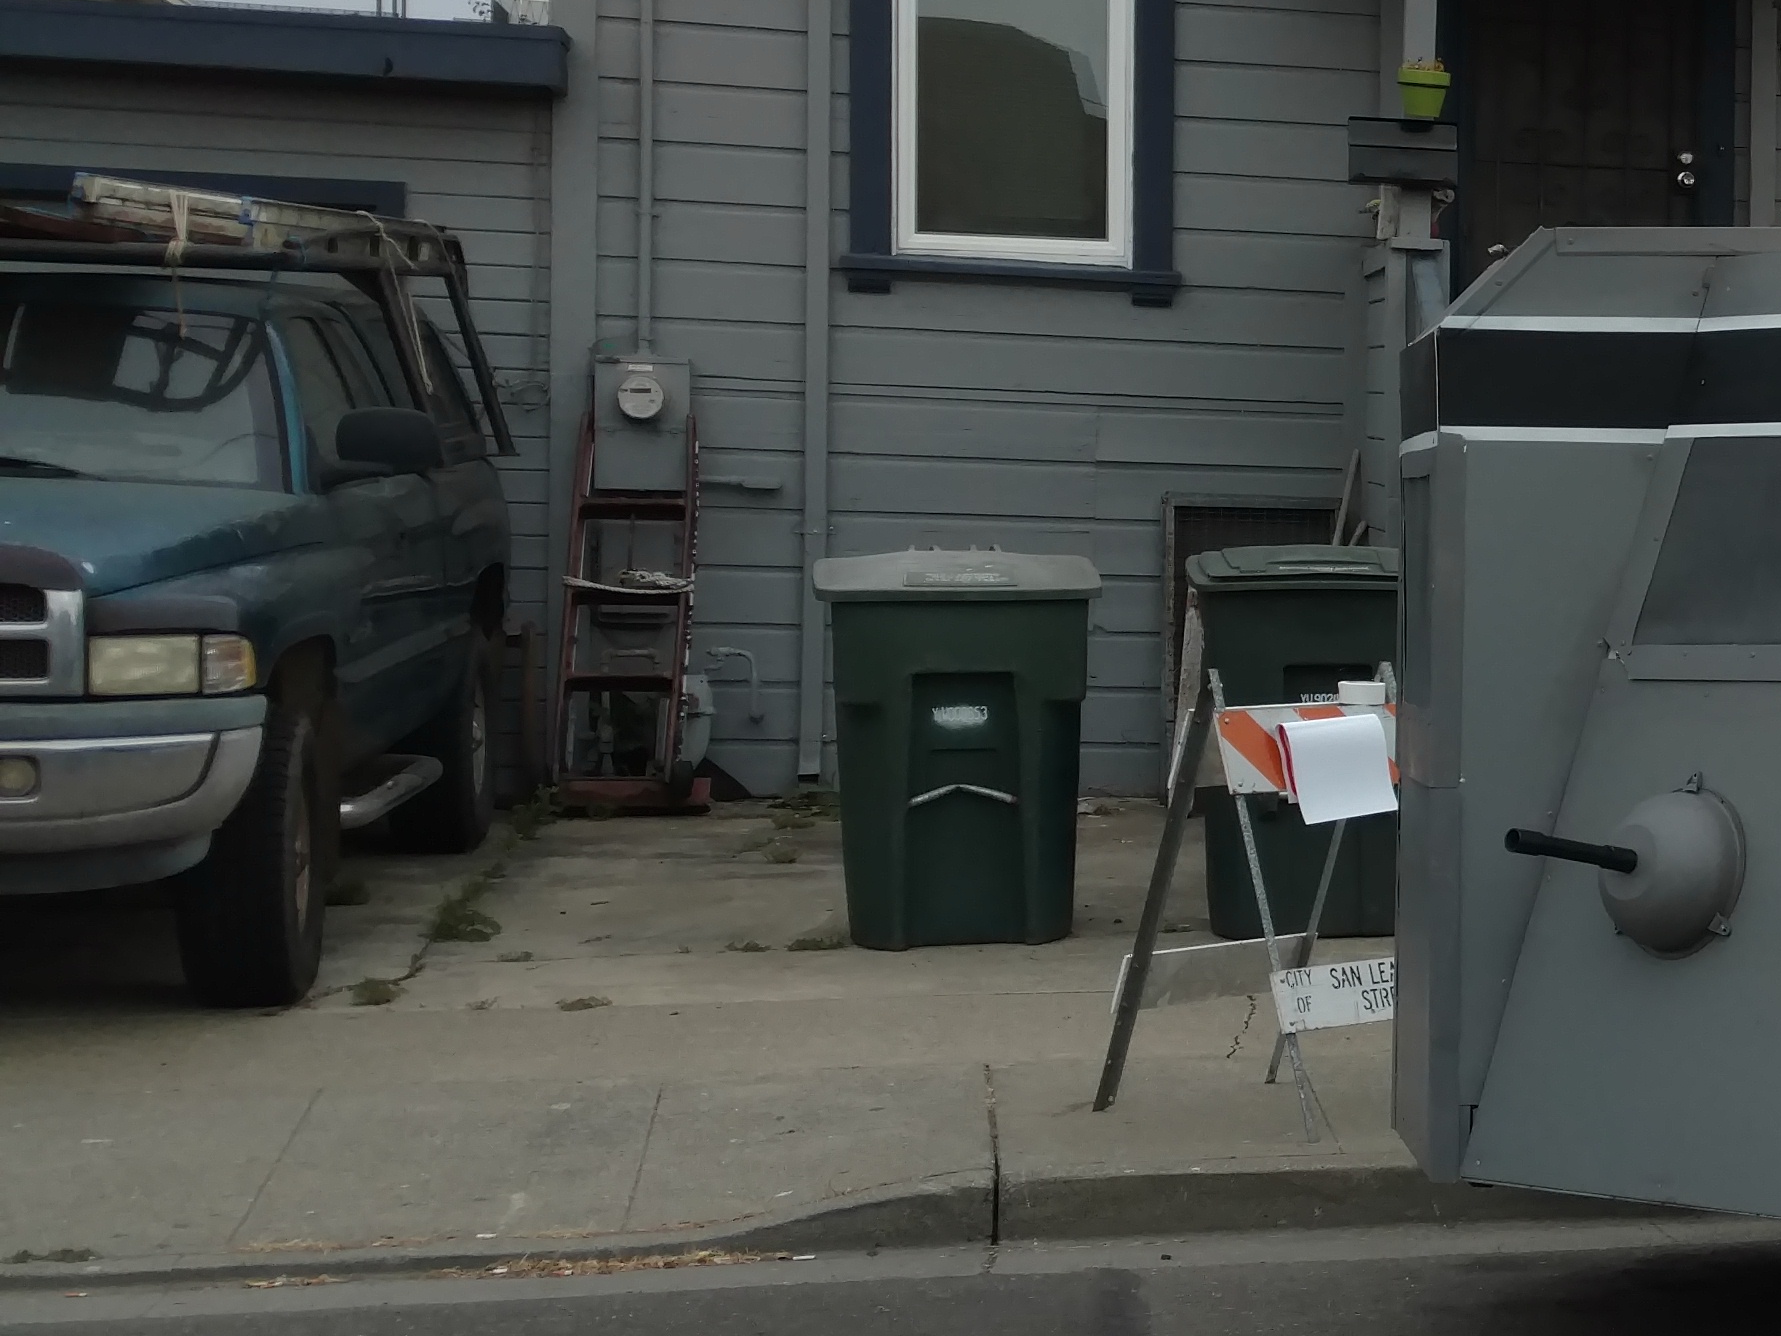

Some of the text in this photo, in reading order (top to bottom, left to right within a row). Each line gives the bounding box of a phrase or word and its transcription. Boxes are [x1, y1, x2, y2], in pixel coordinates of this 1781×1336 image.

[1285, 969, 1312, 988] CITY
[1329, 965, 1362, 990] SAN
[1297, 995, 1312, 1014] OF
